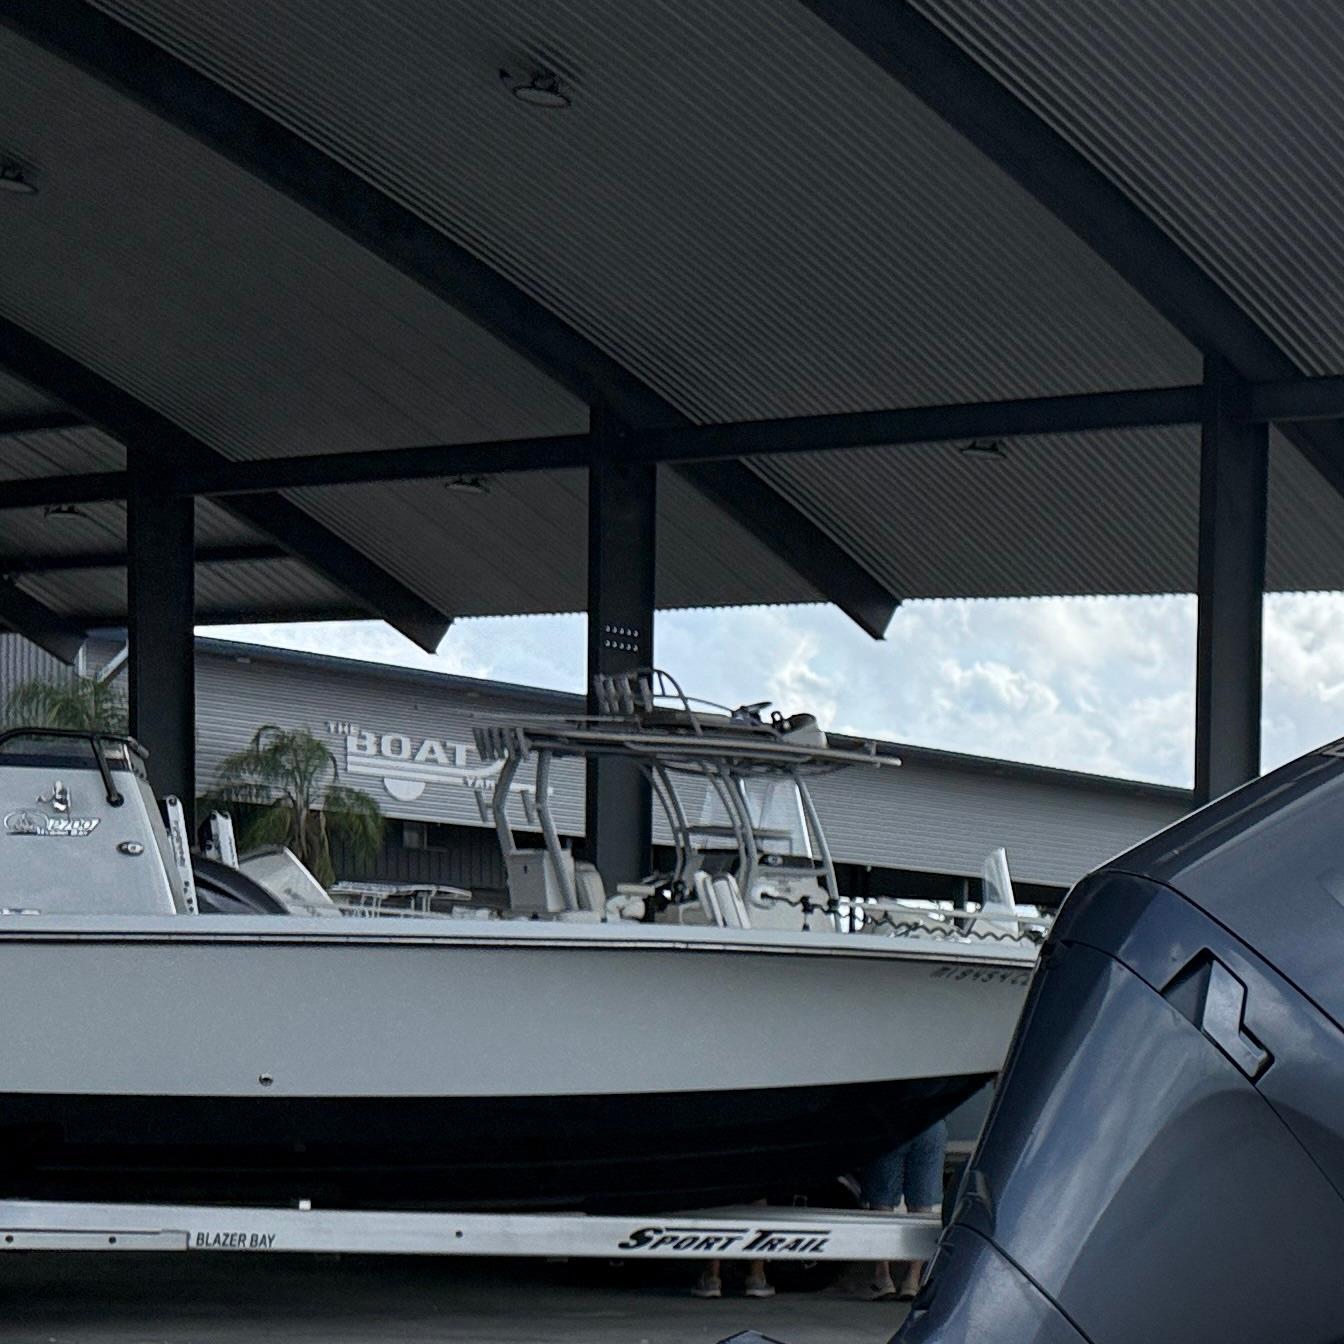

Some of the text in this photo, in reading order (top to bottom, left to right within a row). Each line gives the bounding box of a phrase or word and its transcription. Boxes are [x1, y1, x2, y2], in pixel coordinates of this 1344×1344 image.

[325, 720, 361, 736] THE
[347, 731, 477, 767] BOAT
[196, 1231, 276, 1249] BLAZER BAY
